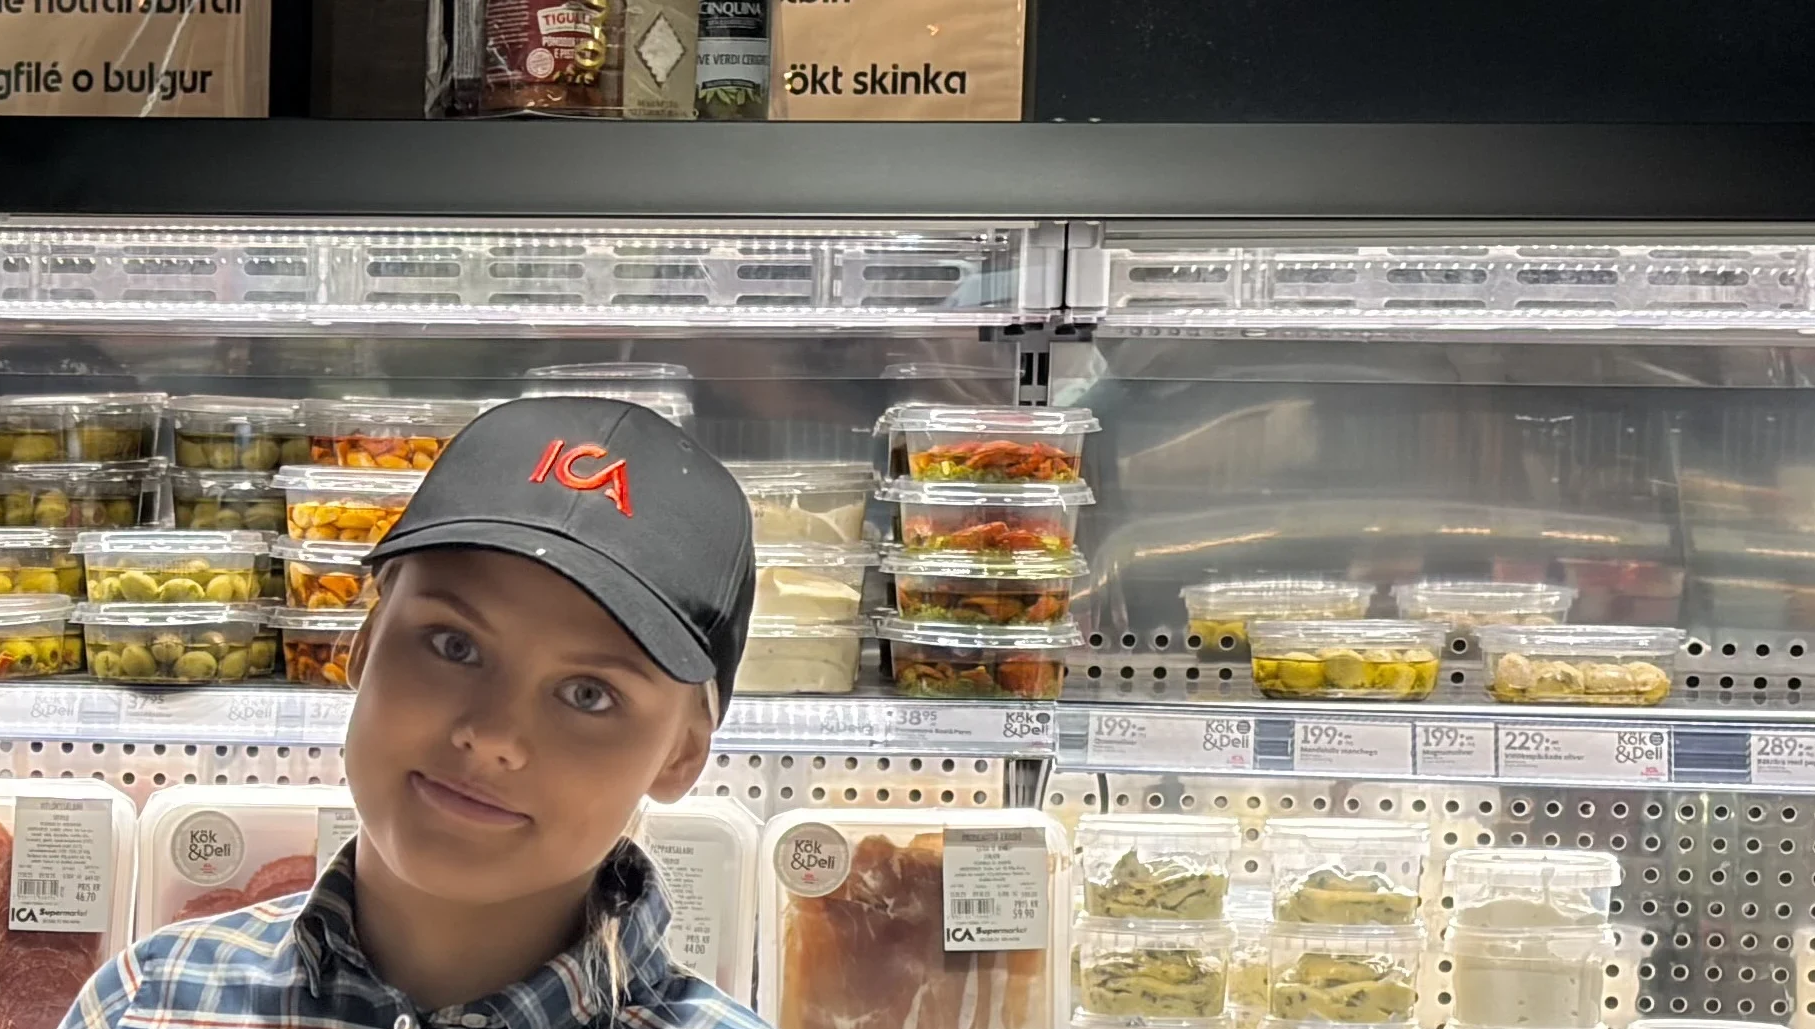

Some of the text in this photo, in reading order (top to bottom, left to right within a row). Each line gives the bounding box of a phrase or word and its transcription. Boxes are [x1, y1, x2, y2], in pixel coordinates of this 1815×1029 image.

[72, 71, 93, 93] o
[104, 62, 212, 100] bulgur
[853, 63, 967, 95] skinka
[529, 439, 634, 518] ICA
[30, 703, 74, 718] &Deli
[228, 705, 273, 720] &Deli
[1006, 711, 1034, 724] Kök
[1003, 723, 1049, 737] &Deli
[1206, 719, 1234, 734] Kök
[1203, 733, 1250, 751] &Deli
[1618, 731, 1648, 746] Kök
[1615, 746, 1664, 764] &Deli
[189, 829, 218, 844] Kök
[188, 843, 231, 862] &Deli
[794, 839, 822, 855] Kök
[791, 852, 835, 871] &Deli
[11, 907, 38, 923] ICA
[947, 927, 976, 942] ICA
